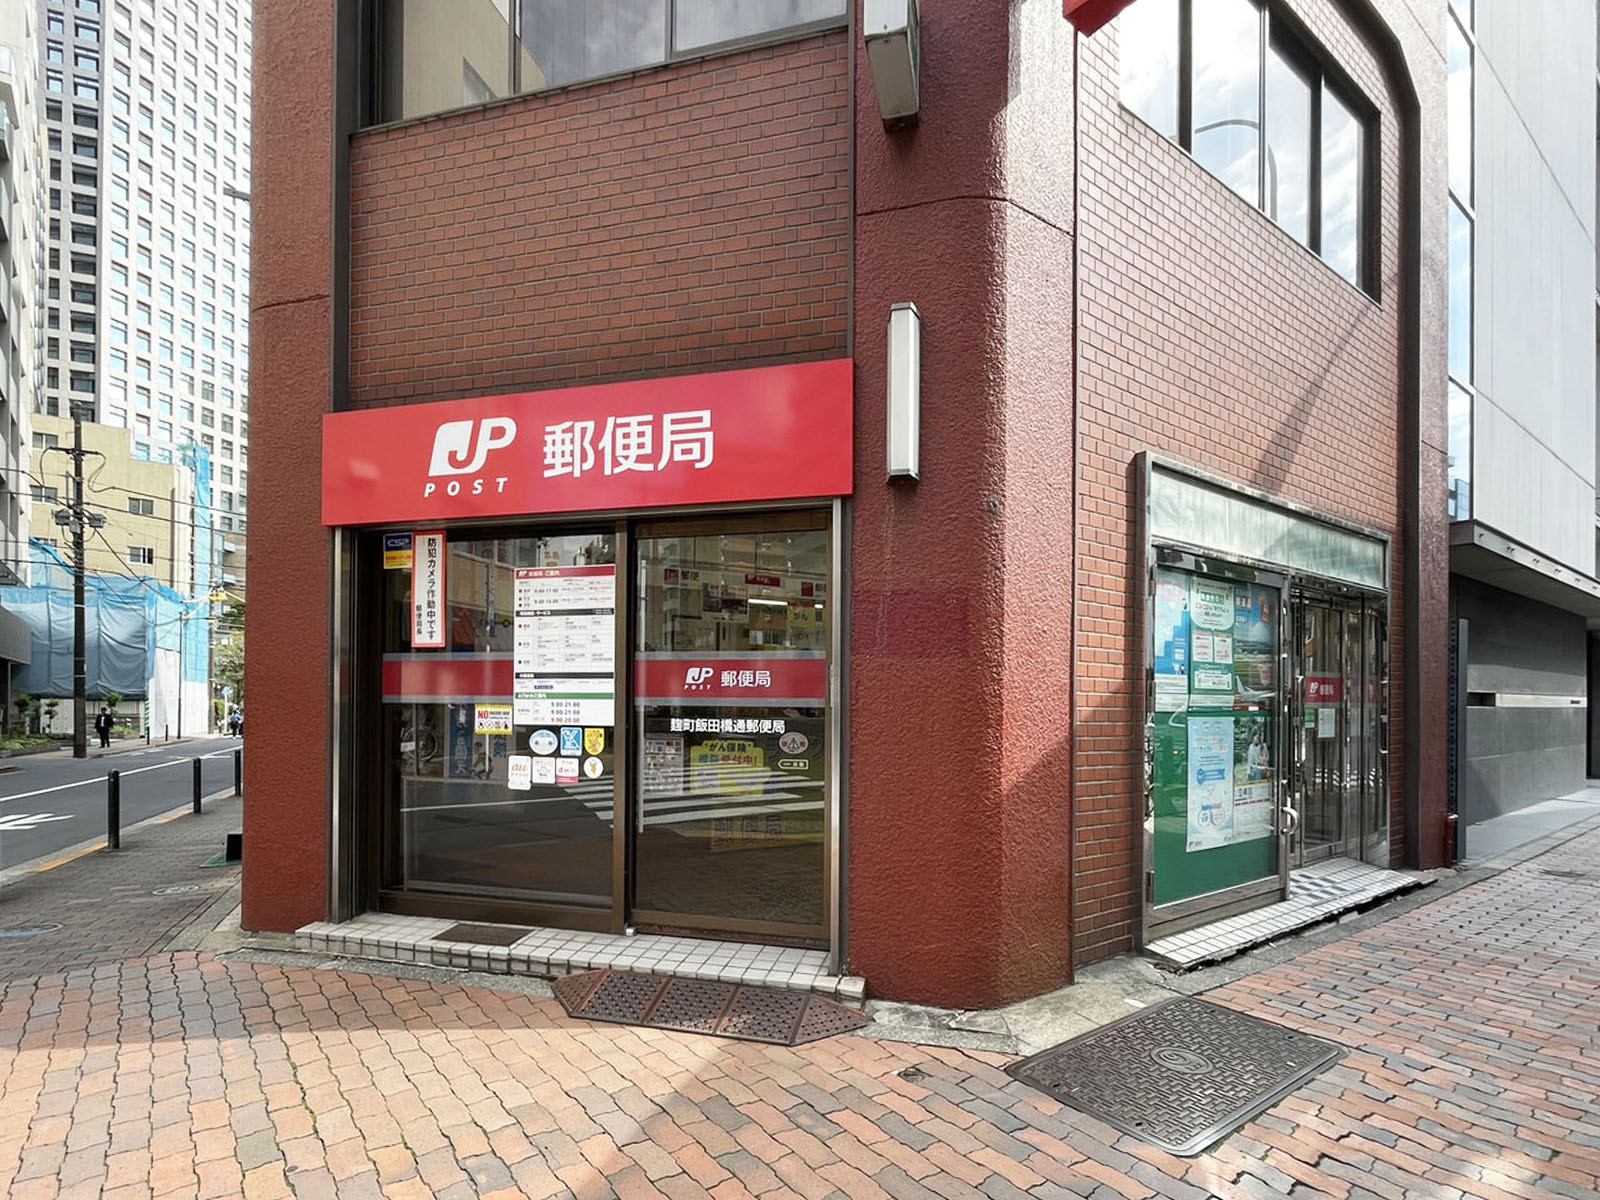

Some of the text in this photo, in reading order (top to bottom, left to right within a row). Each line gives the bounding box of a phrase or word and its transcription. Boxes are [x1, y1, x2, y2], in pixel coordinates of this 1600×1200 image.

[543, 409, 714, 478] 郵便局
[423, 476, 509, 498] POST
[426, 537, 437, 641] 防犯カメラ作動中です
[720, 670, 772, 687] 郵便局
[511, 763, 528, 772] au
